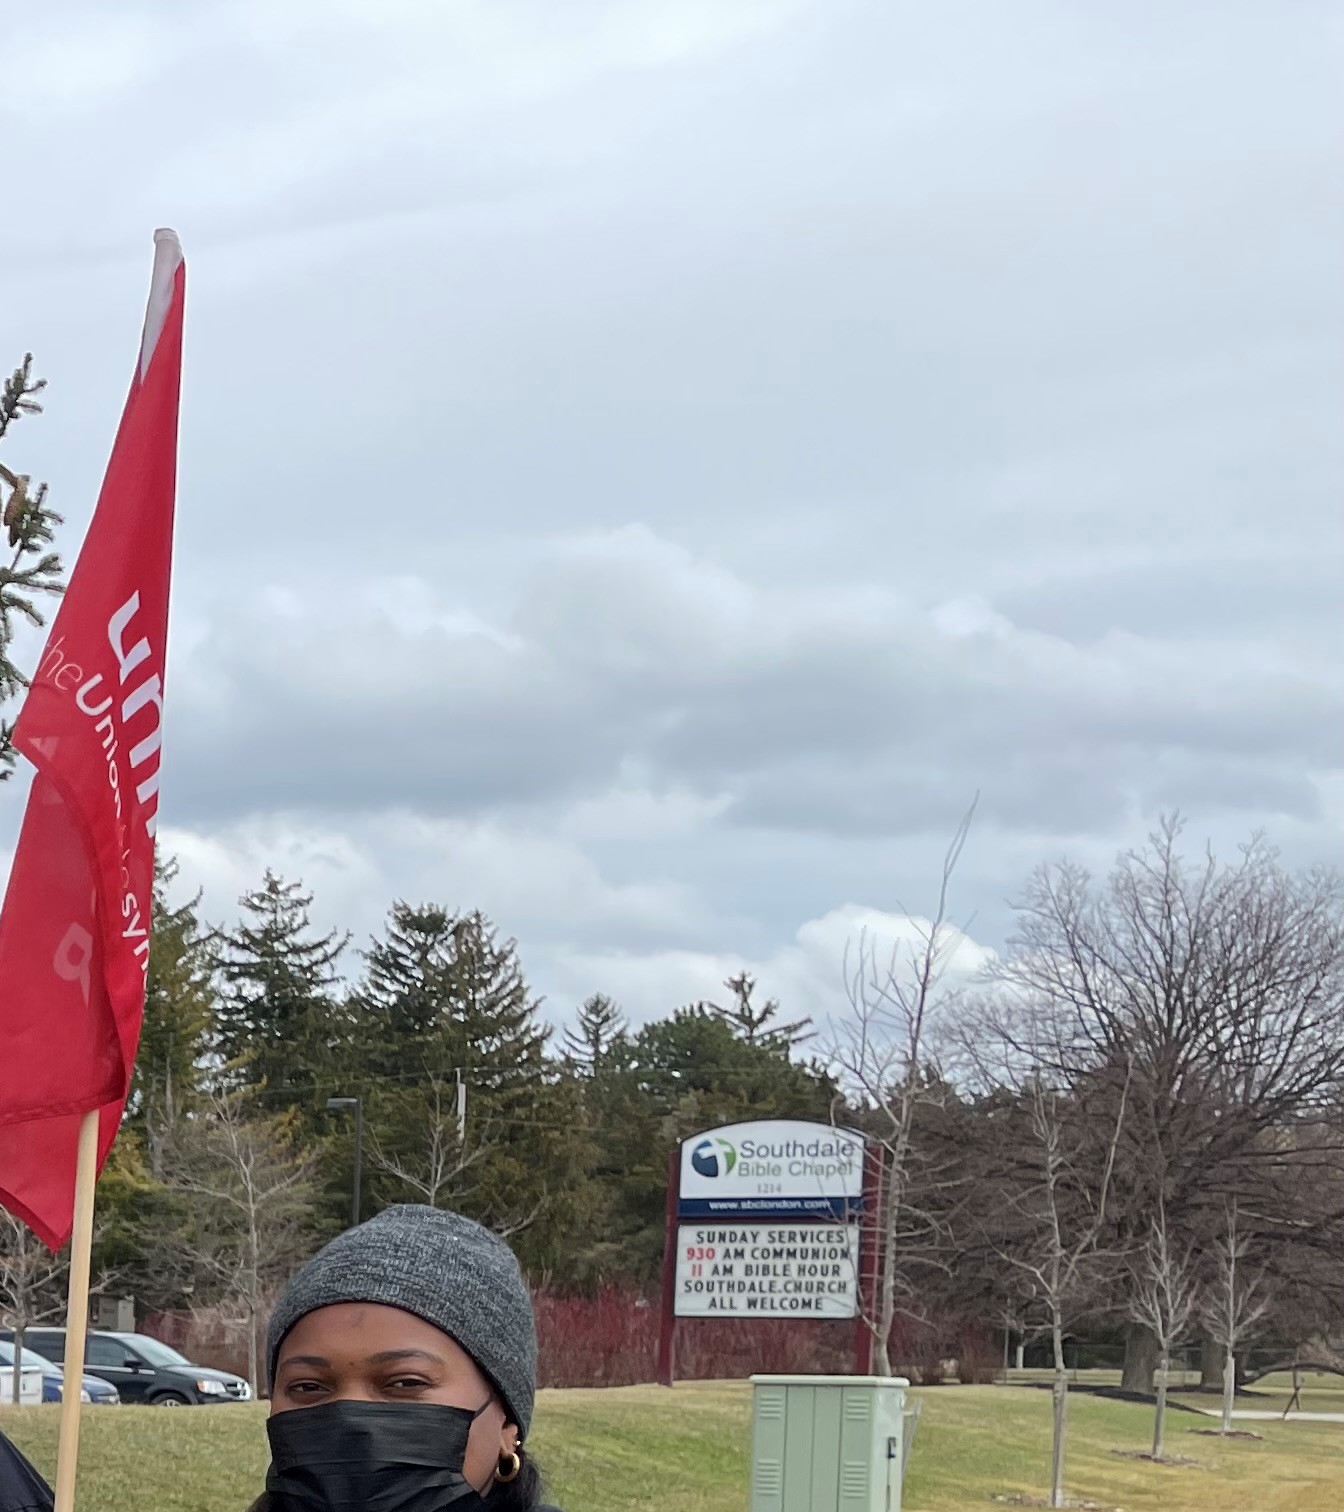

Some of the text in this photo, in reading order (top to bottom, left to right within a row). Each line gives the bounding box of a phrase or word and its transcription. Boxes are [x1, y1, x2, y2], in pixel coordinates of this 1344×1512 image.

[740, 1140, 855, 1159] Southdale
[738, 1161, 853, 1180] Bible Chapel
[757, 1183, 782, 1194] 1214
[696, 1230, 845, 1244] SUNDAY SERVICES
[686, 1247, 850, 1260] 930 AM COMMUNION
[712, 1264, 733, 1277] AM
[744, 1264, 791, 1277] BIBLE
[798, 1264, 841, 1277] HOUR
[708, 1297, 823, 1310] ALL WELCOME
